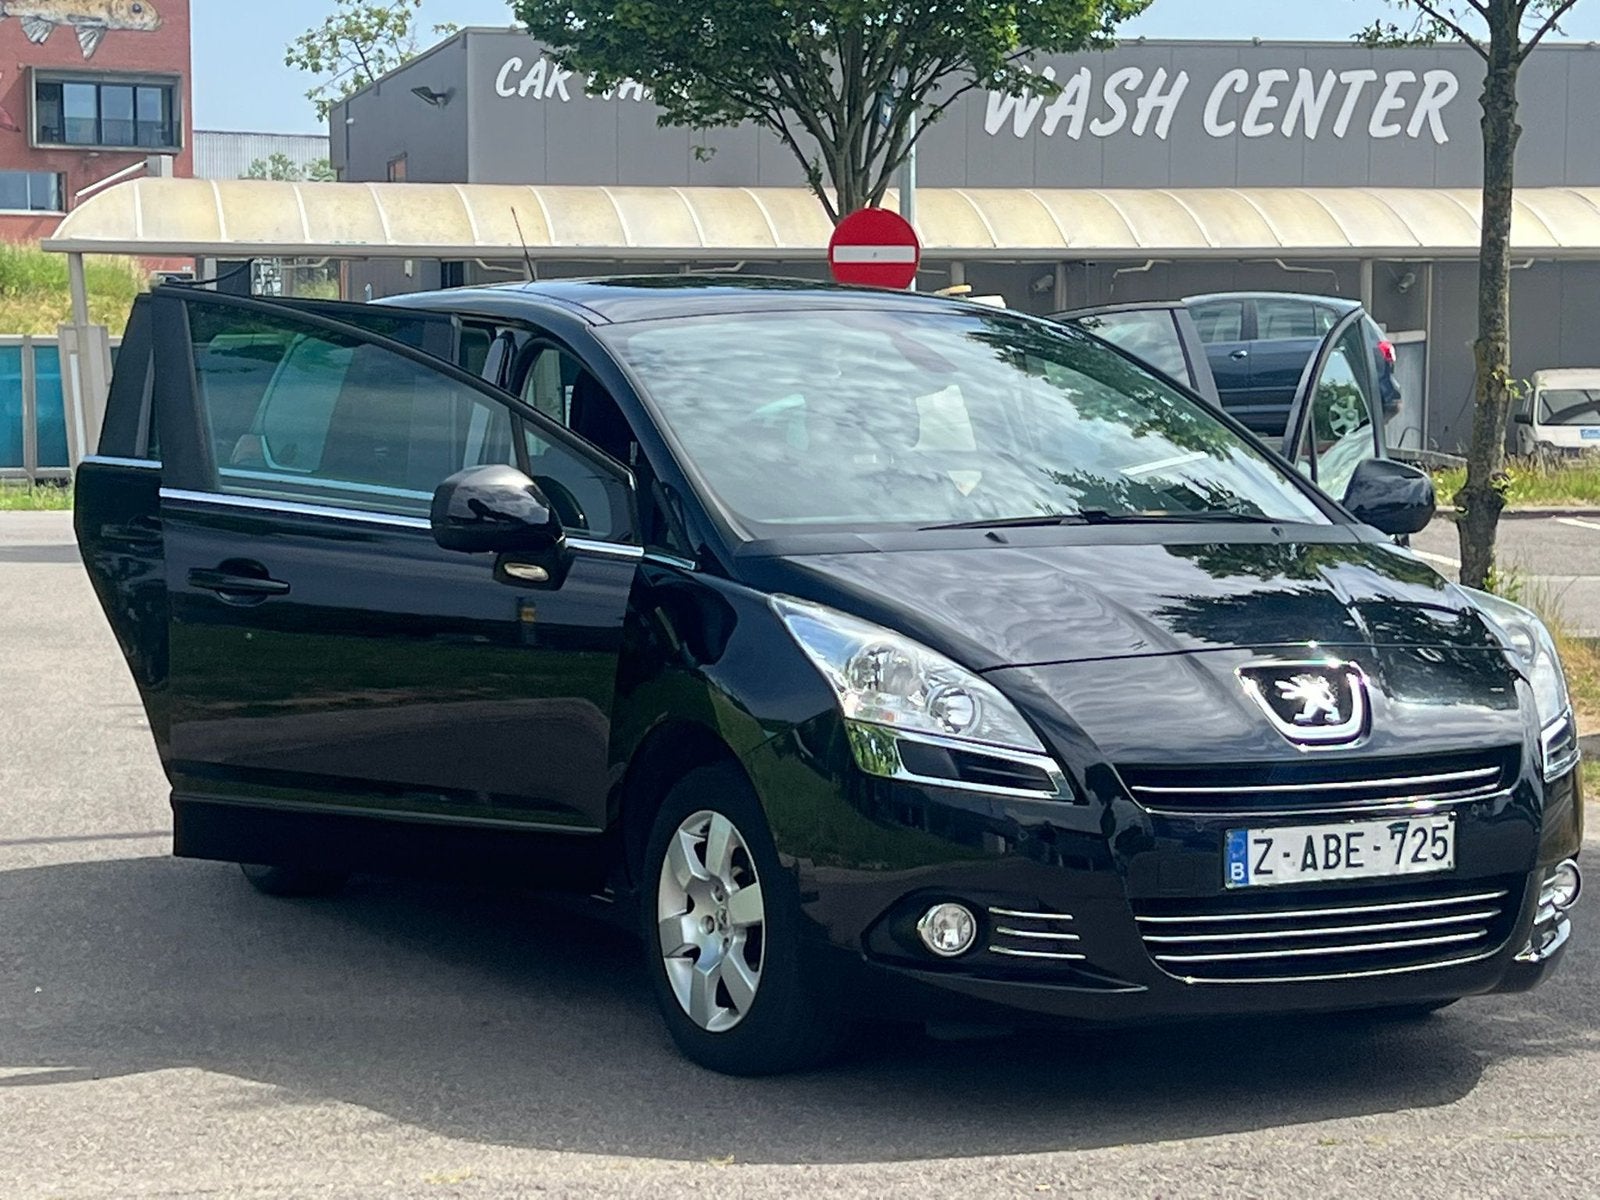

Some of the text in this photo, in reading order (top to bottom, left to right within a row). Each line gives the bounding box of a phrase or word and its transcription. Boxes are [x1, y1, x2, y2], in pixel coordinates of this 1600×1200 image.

[984, 65, 1459, 144] WASH CENTER
[1230, 862, 1246, 881] B
